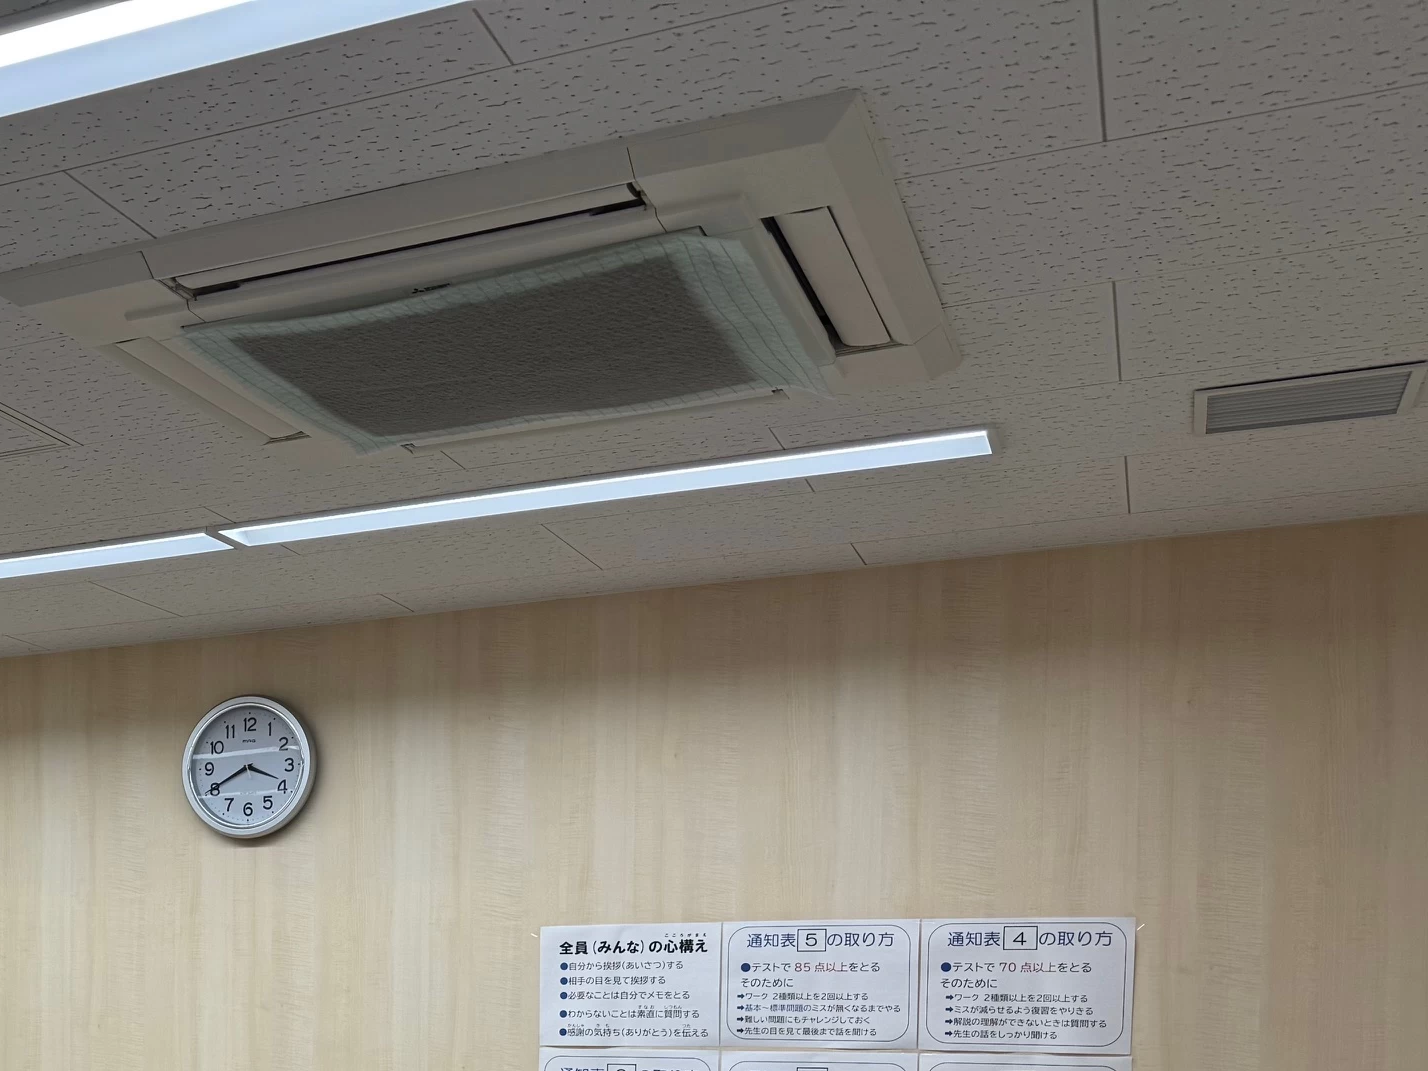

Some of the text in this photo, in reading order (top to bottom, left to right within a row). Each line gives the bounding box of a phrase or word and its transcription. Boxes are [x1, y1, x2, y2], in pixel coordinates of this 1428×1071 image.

[244, 718, 256, 732] 12
[268, 722, 272, 736] 1
[226, 725, 234, 739] 11
[210, 741, 224, 754] 10
[279, 737, 288, 751] 2
[205, 762, 214, 776] 9
[284, 758, 294, 772] 3
[210, 783, 220, 796] 8
[278, 780, 287, 794] 4
[224, 798, 234, 812] 7
[243, 802, 253, 816] 6
[263, 796, 272, 810] 5
[559, 939, 708, 954] 全員（みんな）の心構え
[752, 962, 880, 972] テストで 85 点以上をとる
[953, 962, 1092, 973] テストで 70 点以上をとる
[569, 976, 666, 985] 相手の目を見て挨拶する
[741, 978, 794, 987] そのために
[940, 978, 998, 988] そのために
[568, 991, 690, 1000] 必要なことは自分でメモをとる
[773, 992, 868, 1000] 2種類以上を2回以上する
[984, 994, 1088, 1003] 2種類以上を2回以上する
[568, 1009, 700, 1018] わからないことは素直に質問する
[954, 1006, 1093, 1015] ミスが減らせるよう復習をやりきる
[745, 1016, 870, 1024] 難しい問題にもチャレンジしておく
[953, 1018, 1107, 1028] 解説の理解ができないときは質問する
[953, 1030, 1057, 1039] 先生の話をしっかり聞ける
